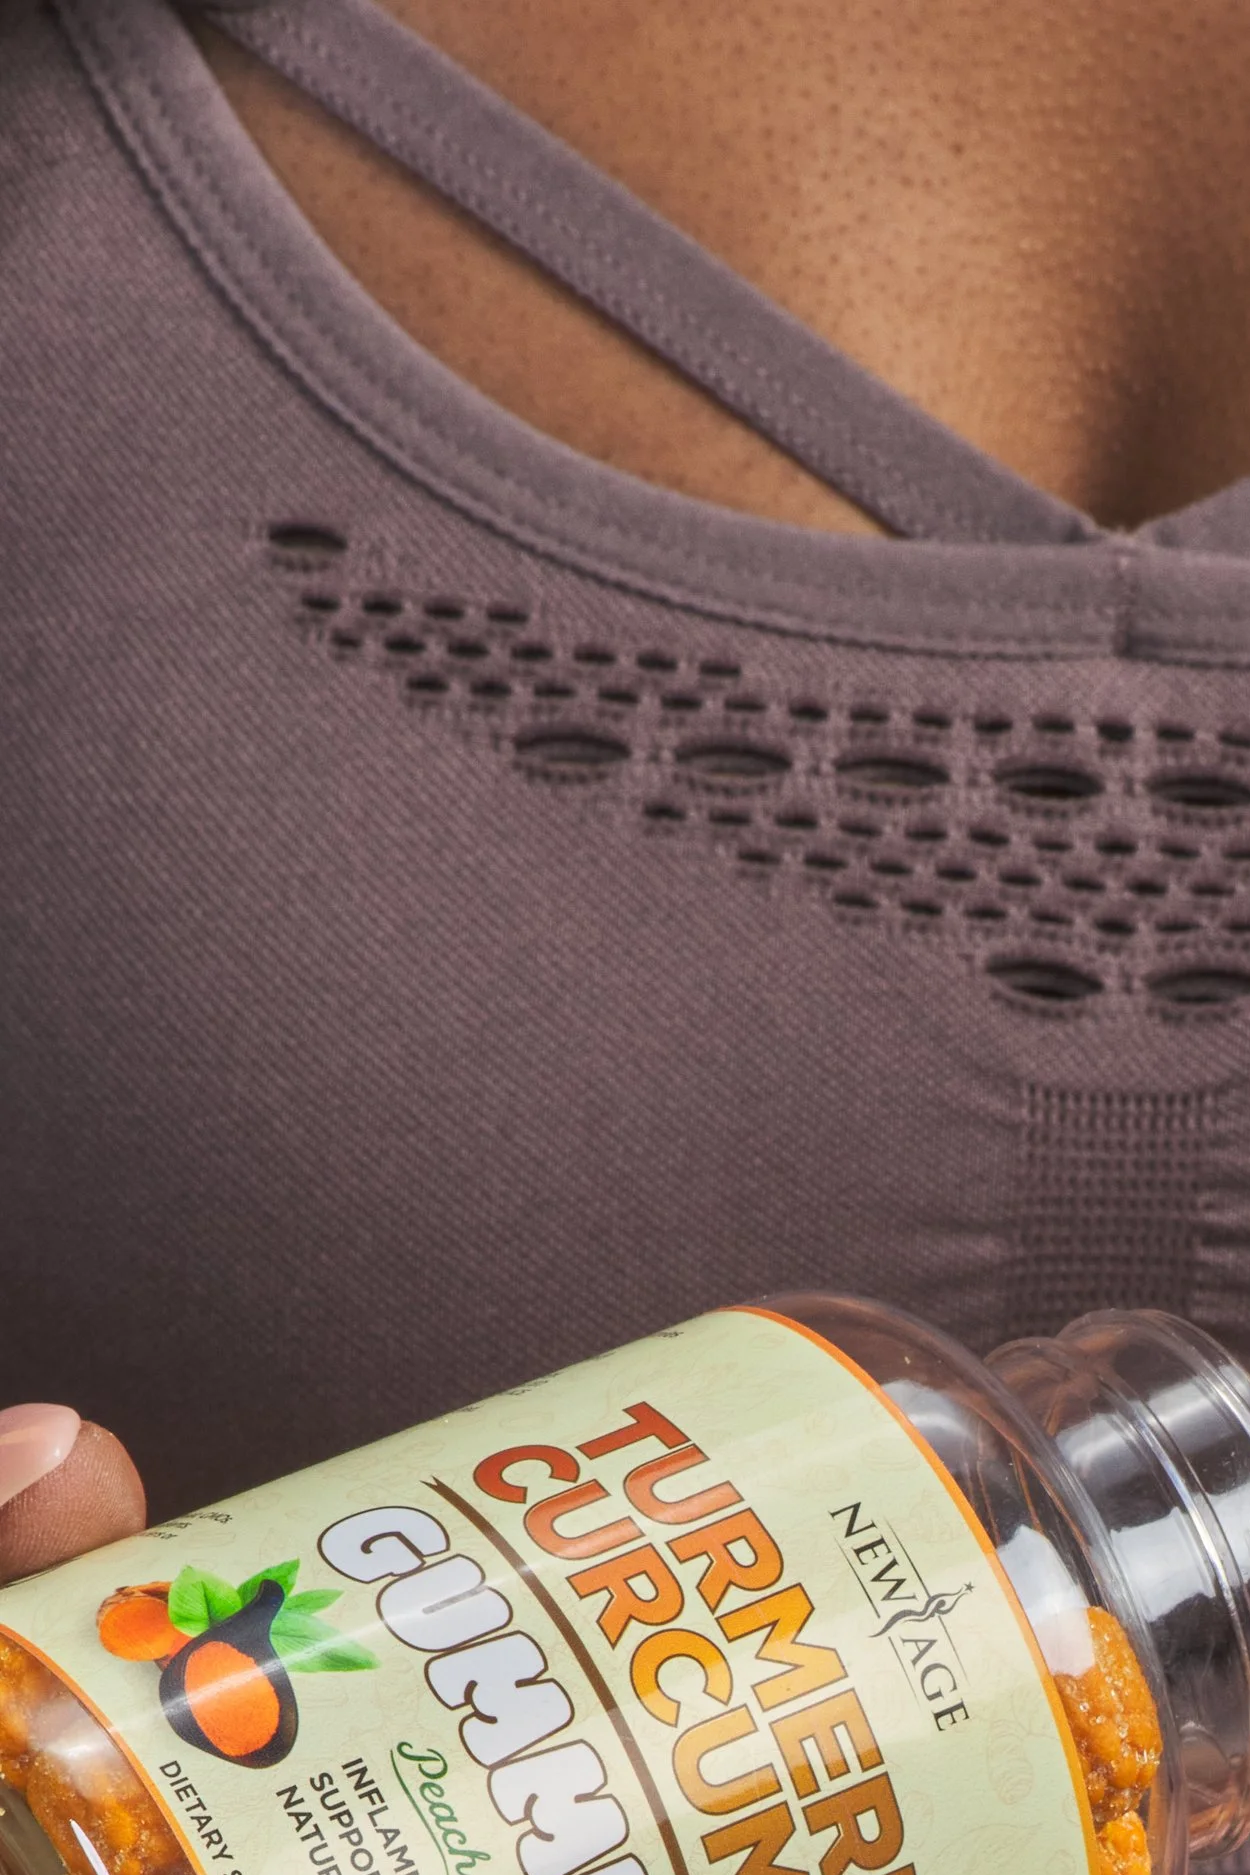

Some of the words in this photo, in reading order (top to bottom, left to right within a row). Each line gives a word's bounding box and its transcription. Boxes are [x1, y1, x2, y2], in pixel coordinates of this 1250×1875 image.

[828, 1501, 919, 1602] NEW
[899, 1634, 970, 1732] AGE
[158, 1760, 234, 1862] DIETARY
